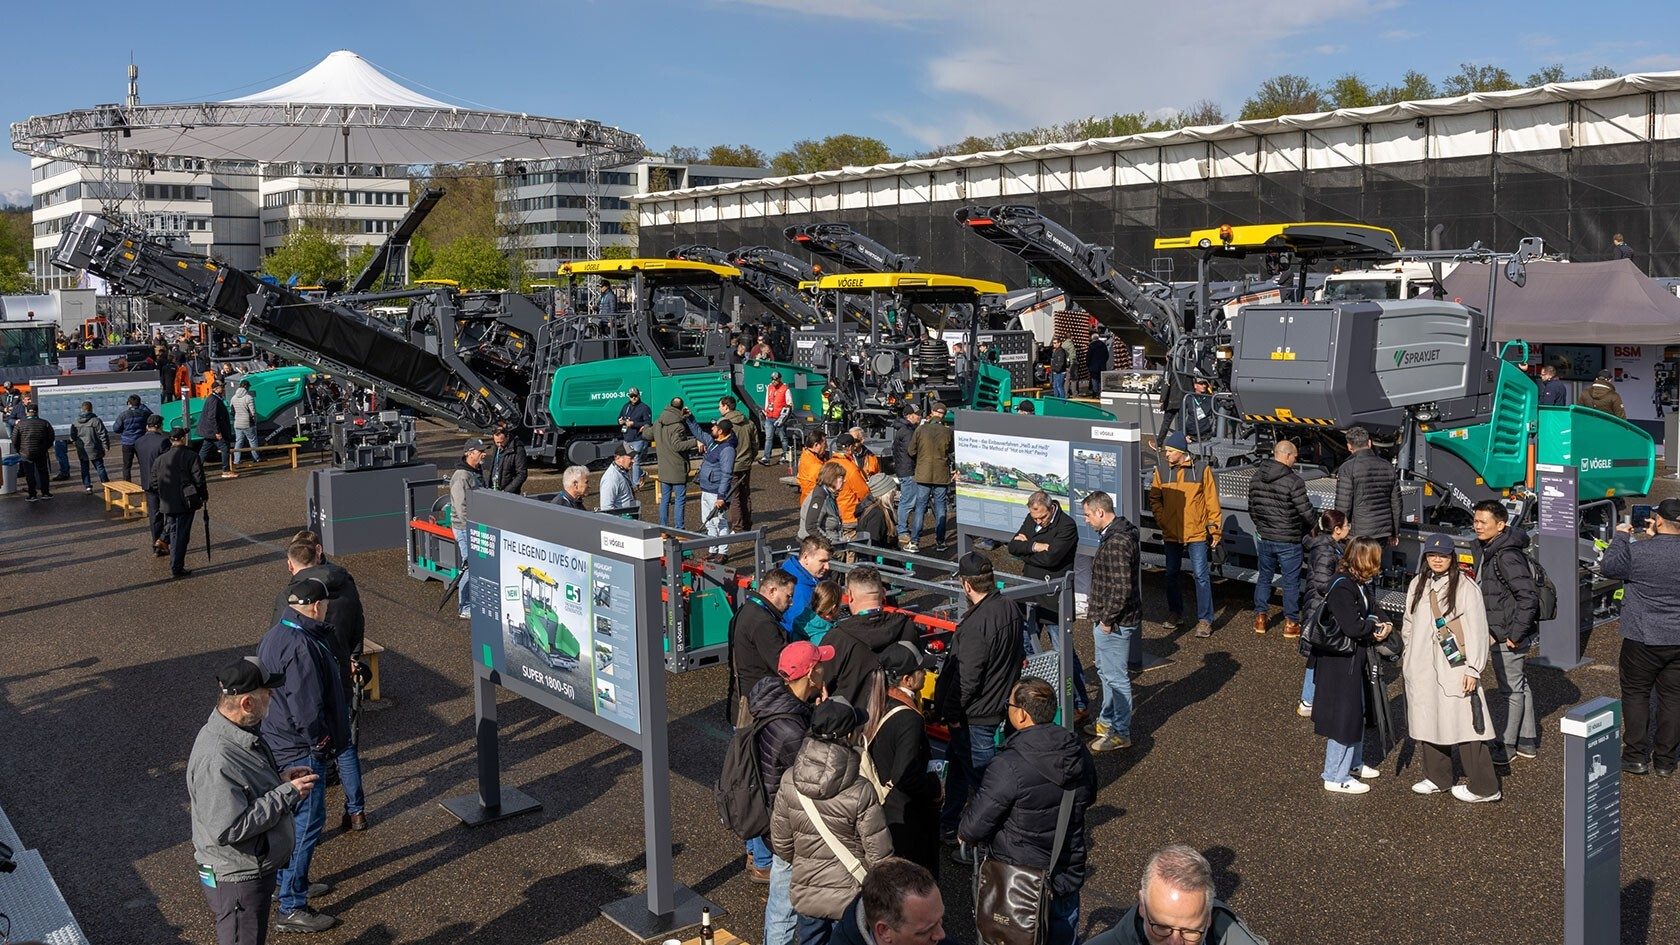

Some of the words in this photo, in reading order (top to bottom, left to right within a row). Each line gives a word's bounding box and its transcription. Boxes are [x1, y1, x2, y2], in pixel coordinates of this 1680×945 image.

[1053, 236, 1072, 253] WIRTGEN
[864, 249, 884, 264] WIRTGEN
[837, 277, 863, 288] VÖGELE
[1404, 348, 1441, 365] SPRAYJET
[1614, 346, 1642, 357] BSM
[602, 391, 625, 400] 3000-3i
[1590, 458, 1612, 469] VÖGELE
[1452, 487, 1472, 509] SUPER
[503, 538, 517, 553] THE
[517, 542, 547, 561] LEGEND
[548, 550, 569, 568] LIVES
[571, 557, 587, 573] ON!
[507, 589, 518, 598] NEW
[521, 664, 545, 685] SUPER
[544, 675, 575, 700] 1800-5(i)
